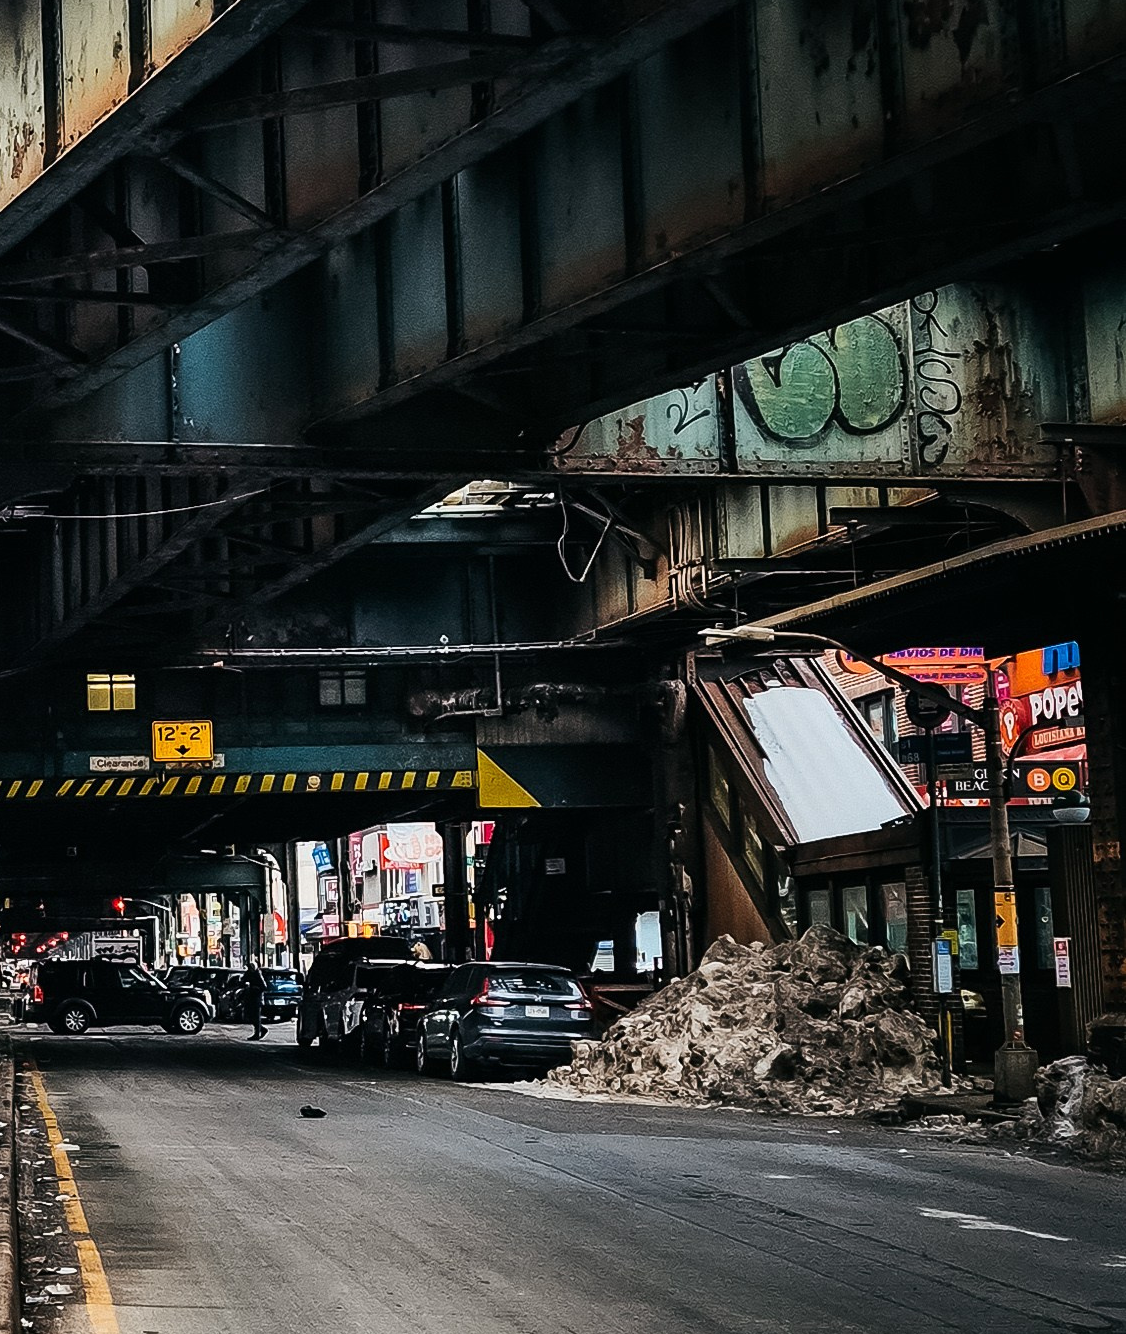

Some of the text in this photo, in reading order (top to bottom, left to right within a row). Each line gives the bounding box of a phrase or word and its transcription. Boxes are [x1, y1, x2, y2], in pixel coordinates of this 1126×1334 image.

[939, 648, 956, 658] DE
[1034, 728, 1076, 746] LOUISIANA
[96, 758, 144, 769] Clearance
[1034, 773, 1045, 786] B
[1058, 772, 1070, 786] Q
[955, 780, 990, 792] BEAC
